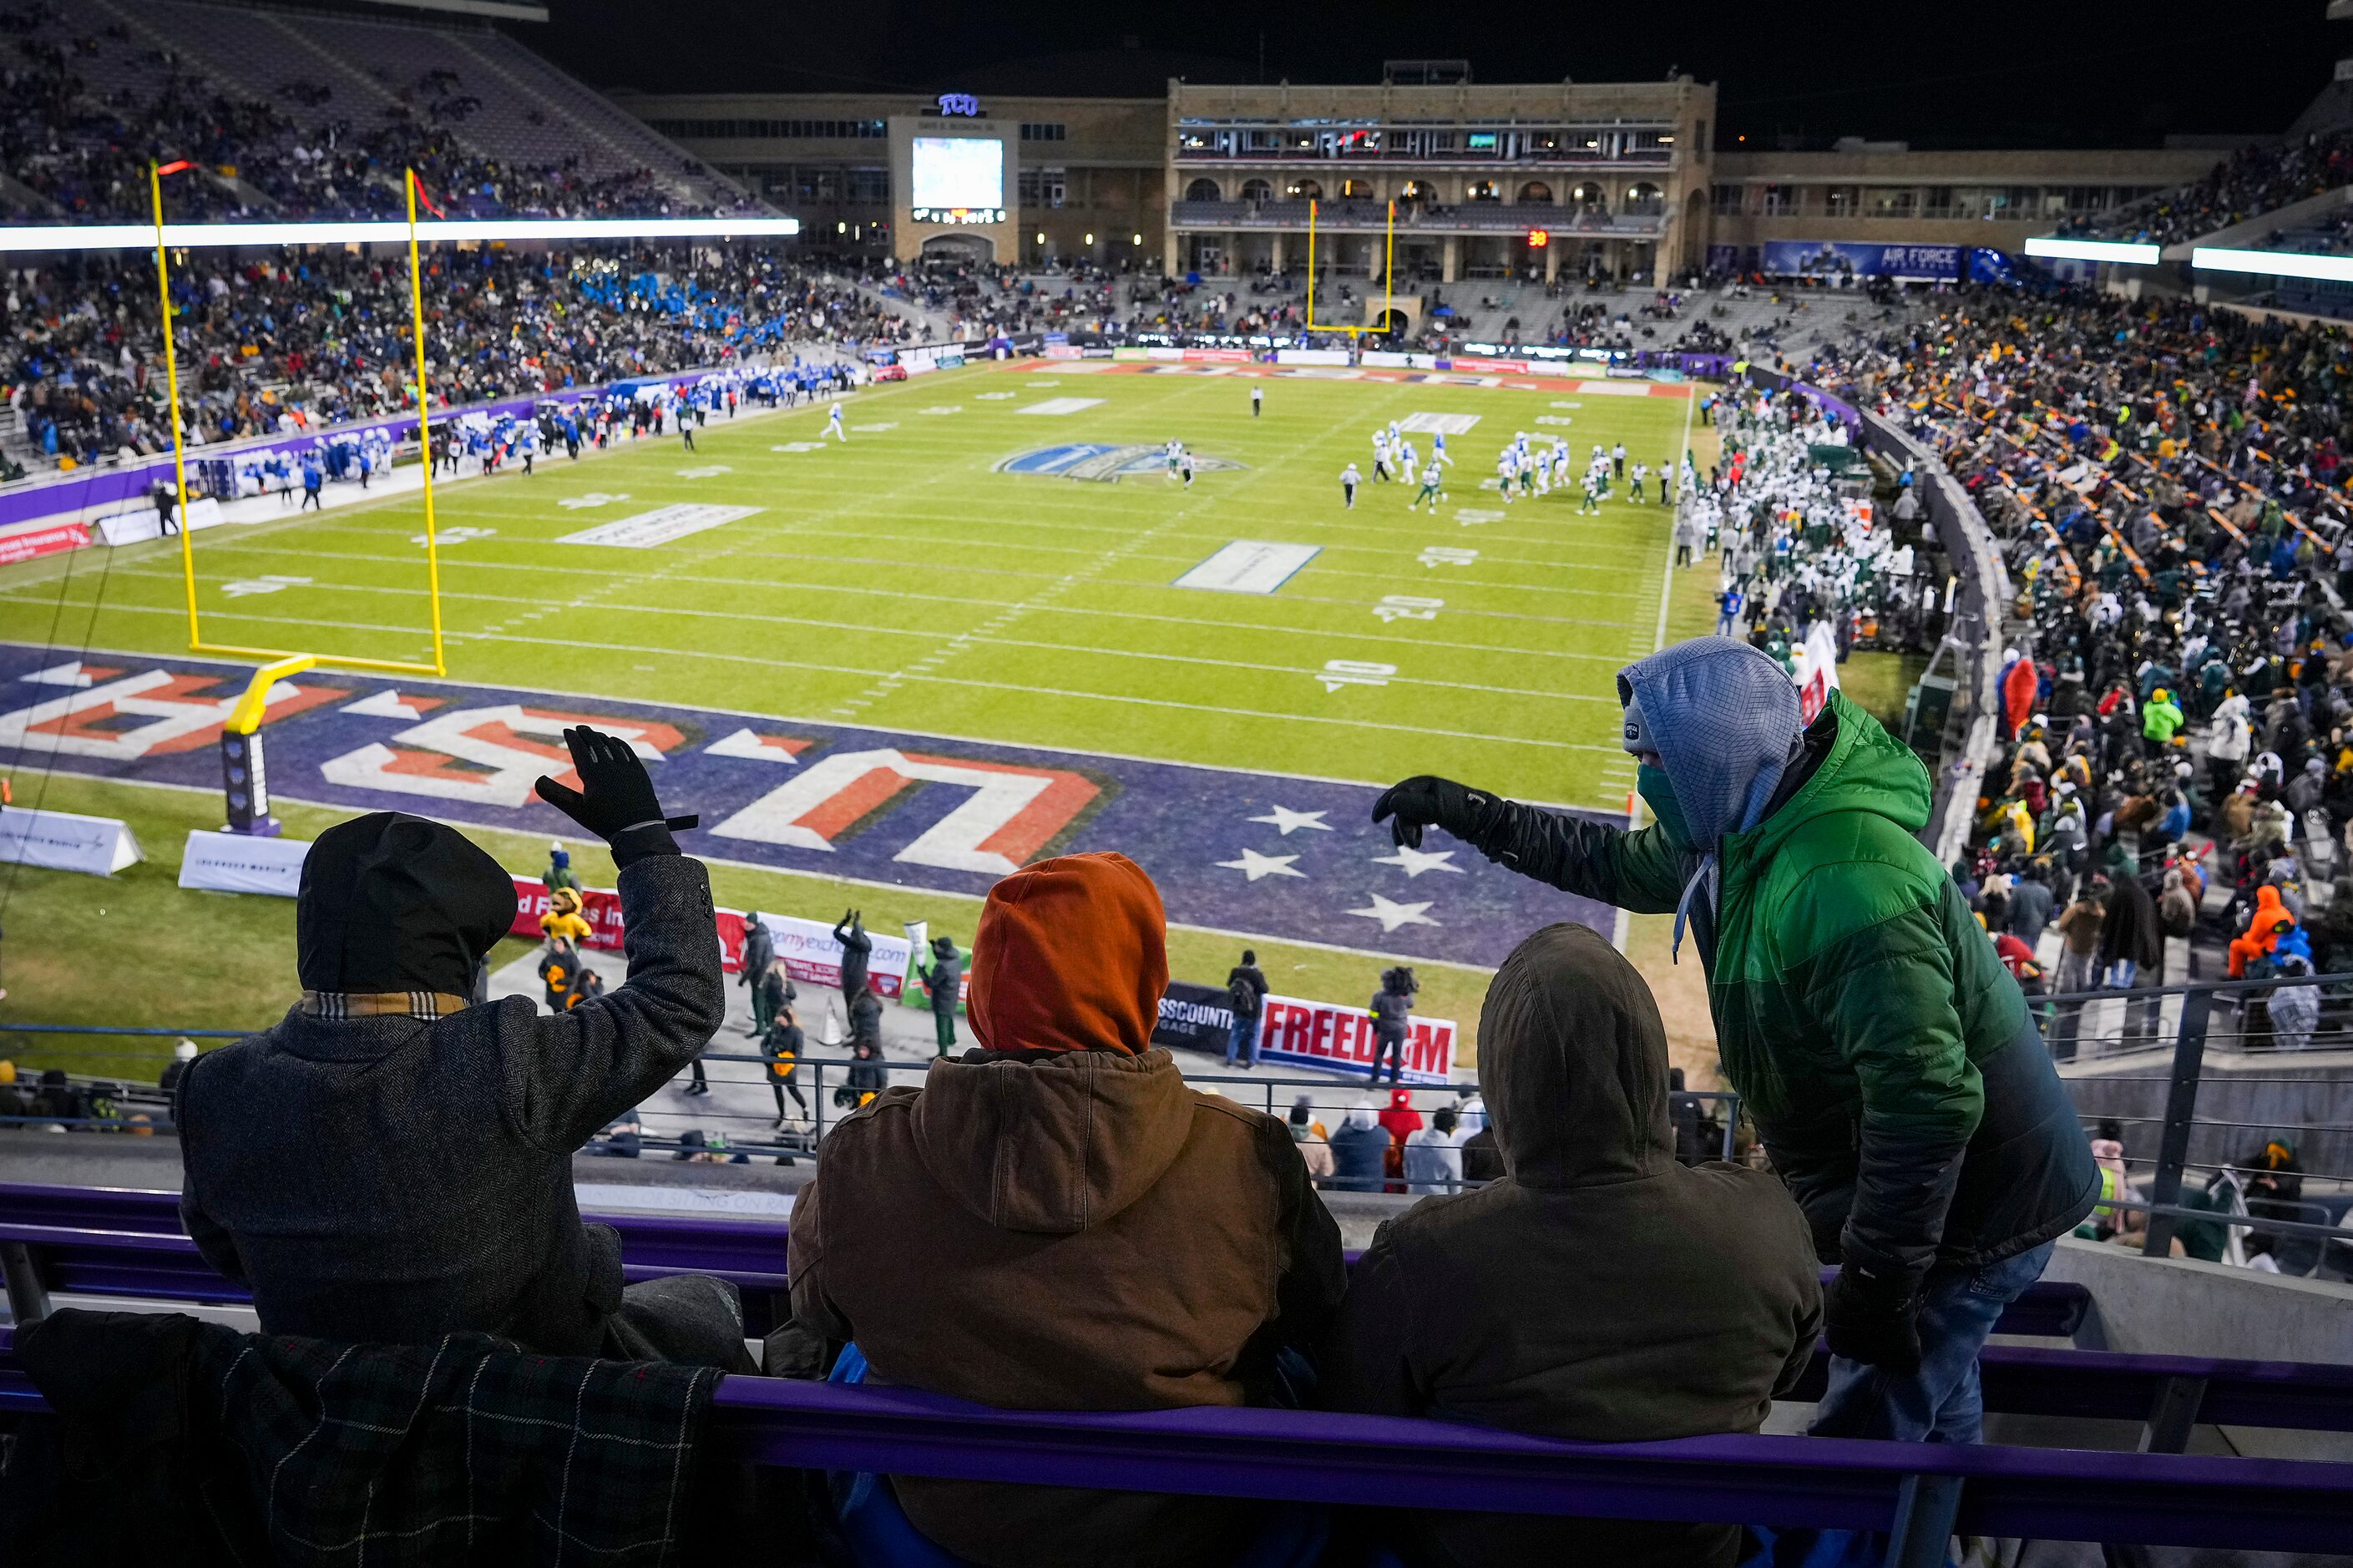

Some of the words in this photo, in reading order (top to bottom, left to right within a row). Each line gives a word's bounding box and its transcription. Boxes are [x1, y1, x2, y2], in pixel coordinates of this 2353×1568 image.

[939, 93, 979, 117] TCU
[1882, 248, 1905, 262] AIR
[1909, 248, 1957, 264] FORCE
[1315, 660, 1398, 686] 10
[1157, 998, 1234, 1030] SSCOUNT
[1158, 1019, 1197, 1036] GAGE
[1262, 1002, 1451, 1075] FREEDM
